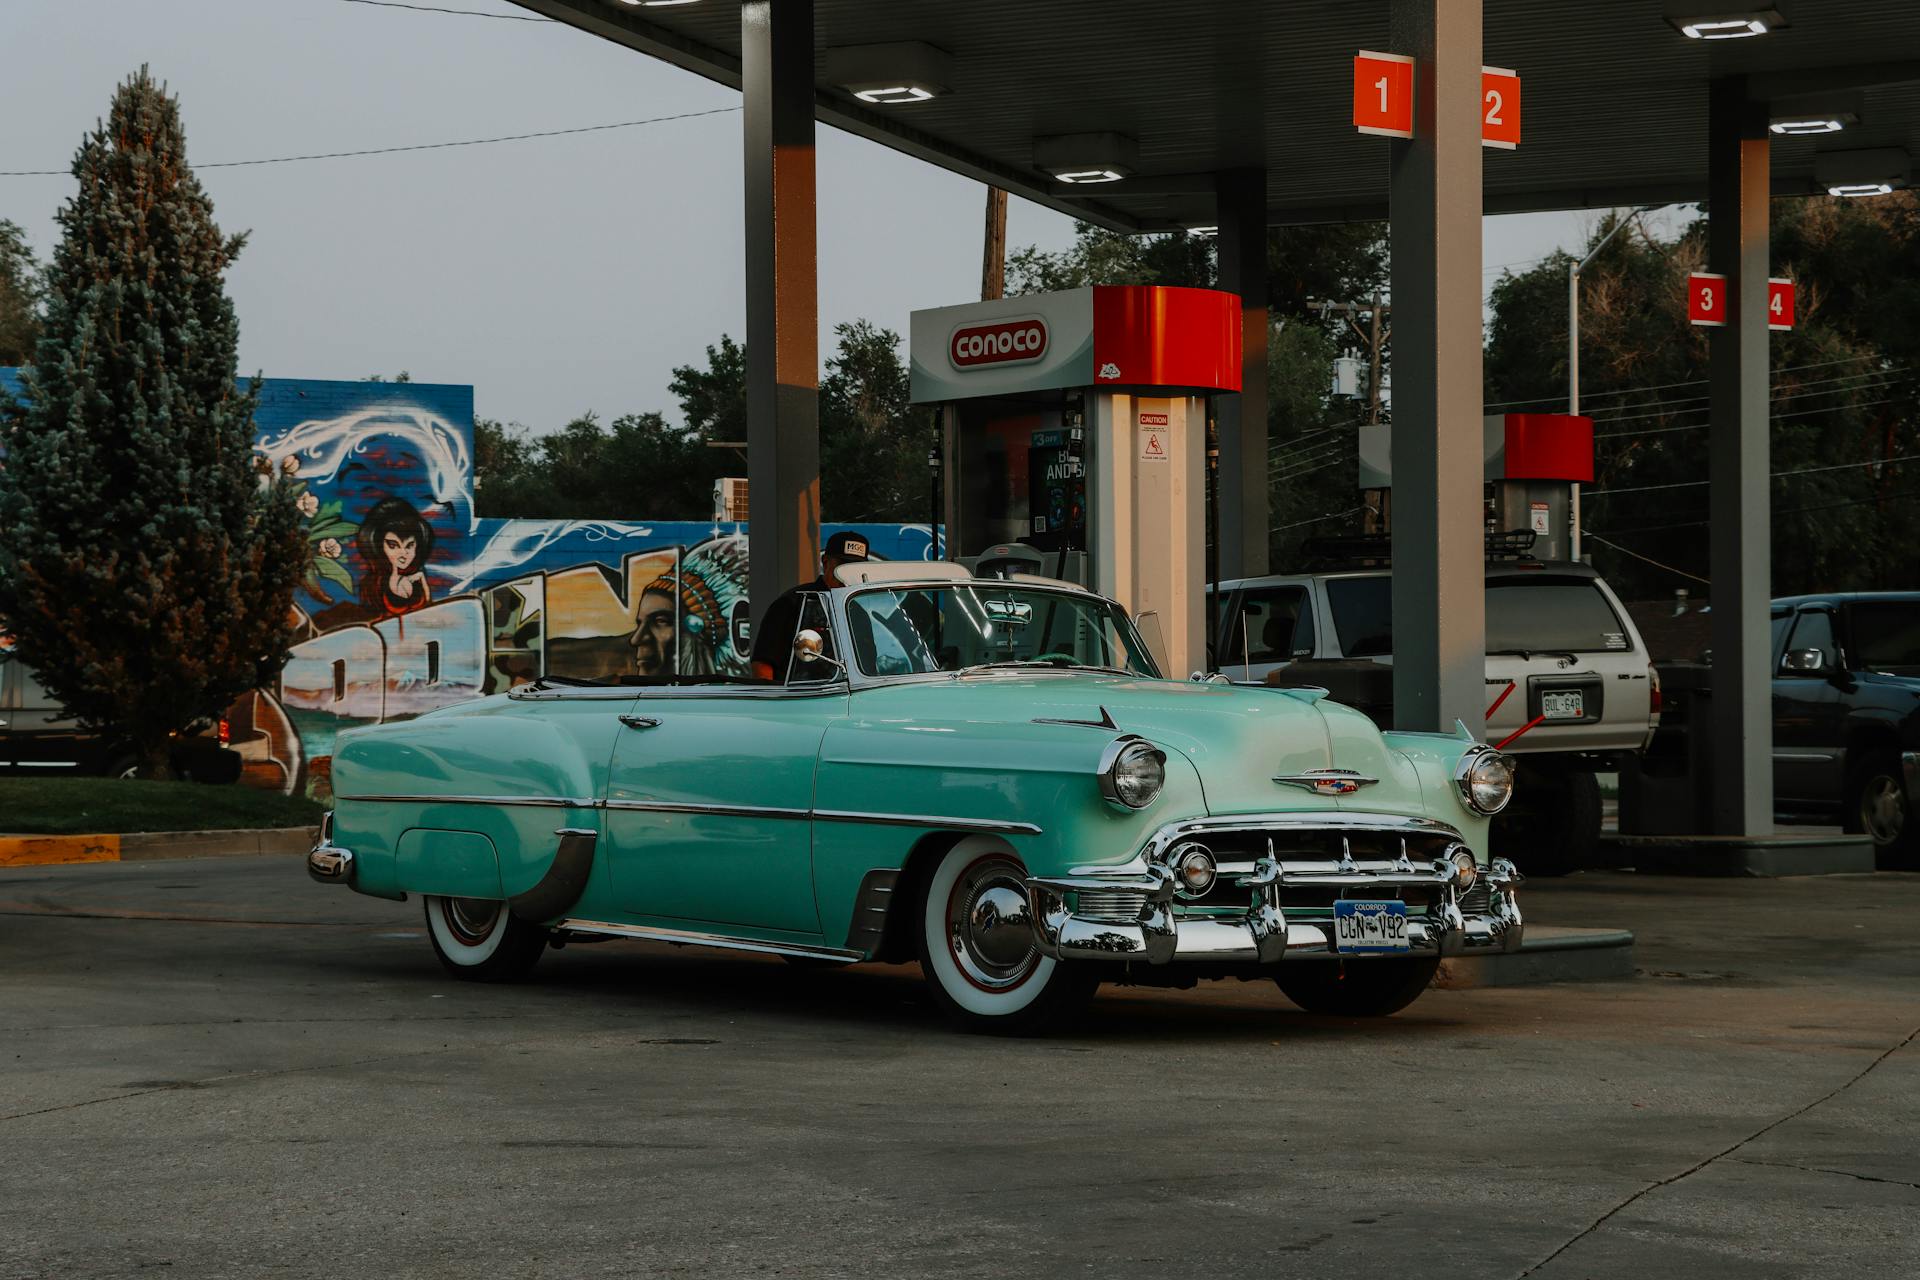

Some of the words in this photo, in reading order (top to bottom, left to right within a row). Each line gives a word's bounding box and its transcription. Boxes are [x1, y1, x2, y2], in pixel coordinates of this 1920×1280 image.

[1374, 76, 1389, 113] 1
[1484, 89, 1504, 126] 2
[1700, 286, 1714, 312] 3
[1769, 292, 1784, 316] 4
[1141, 415, 1167, 424] CAUTION
[1047, 464, 1071, 480] AND
[1354, 903, 1388, 911] COLORADO
[1340, 915, 1365, 939] CGN
[1378, 915, 1405, 939] V92
